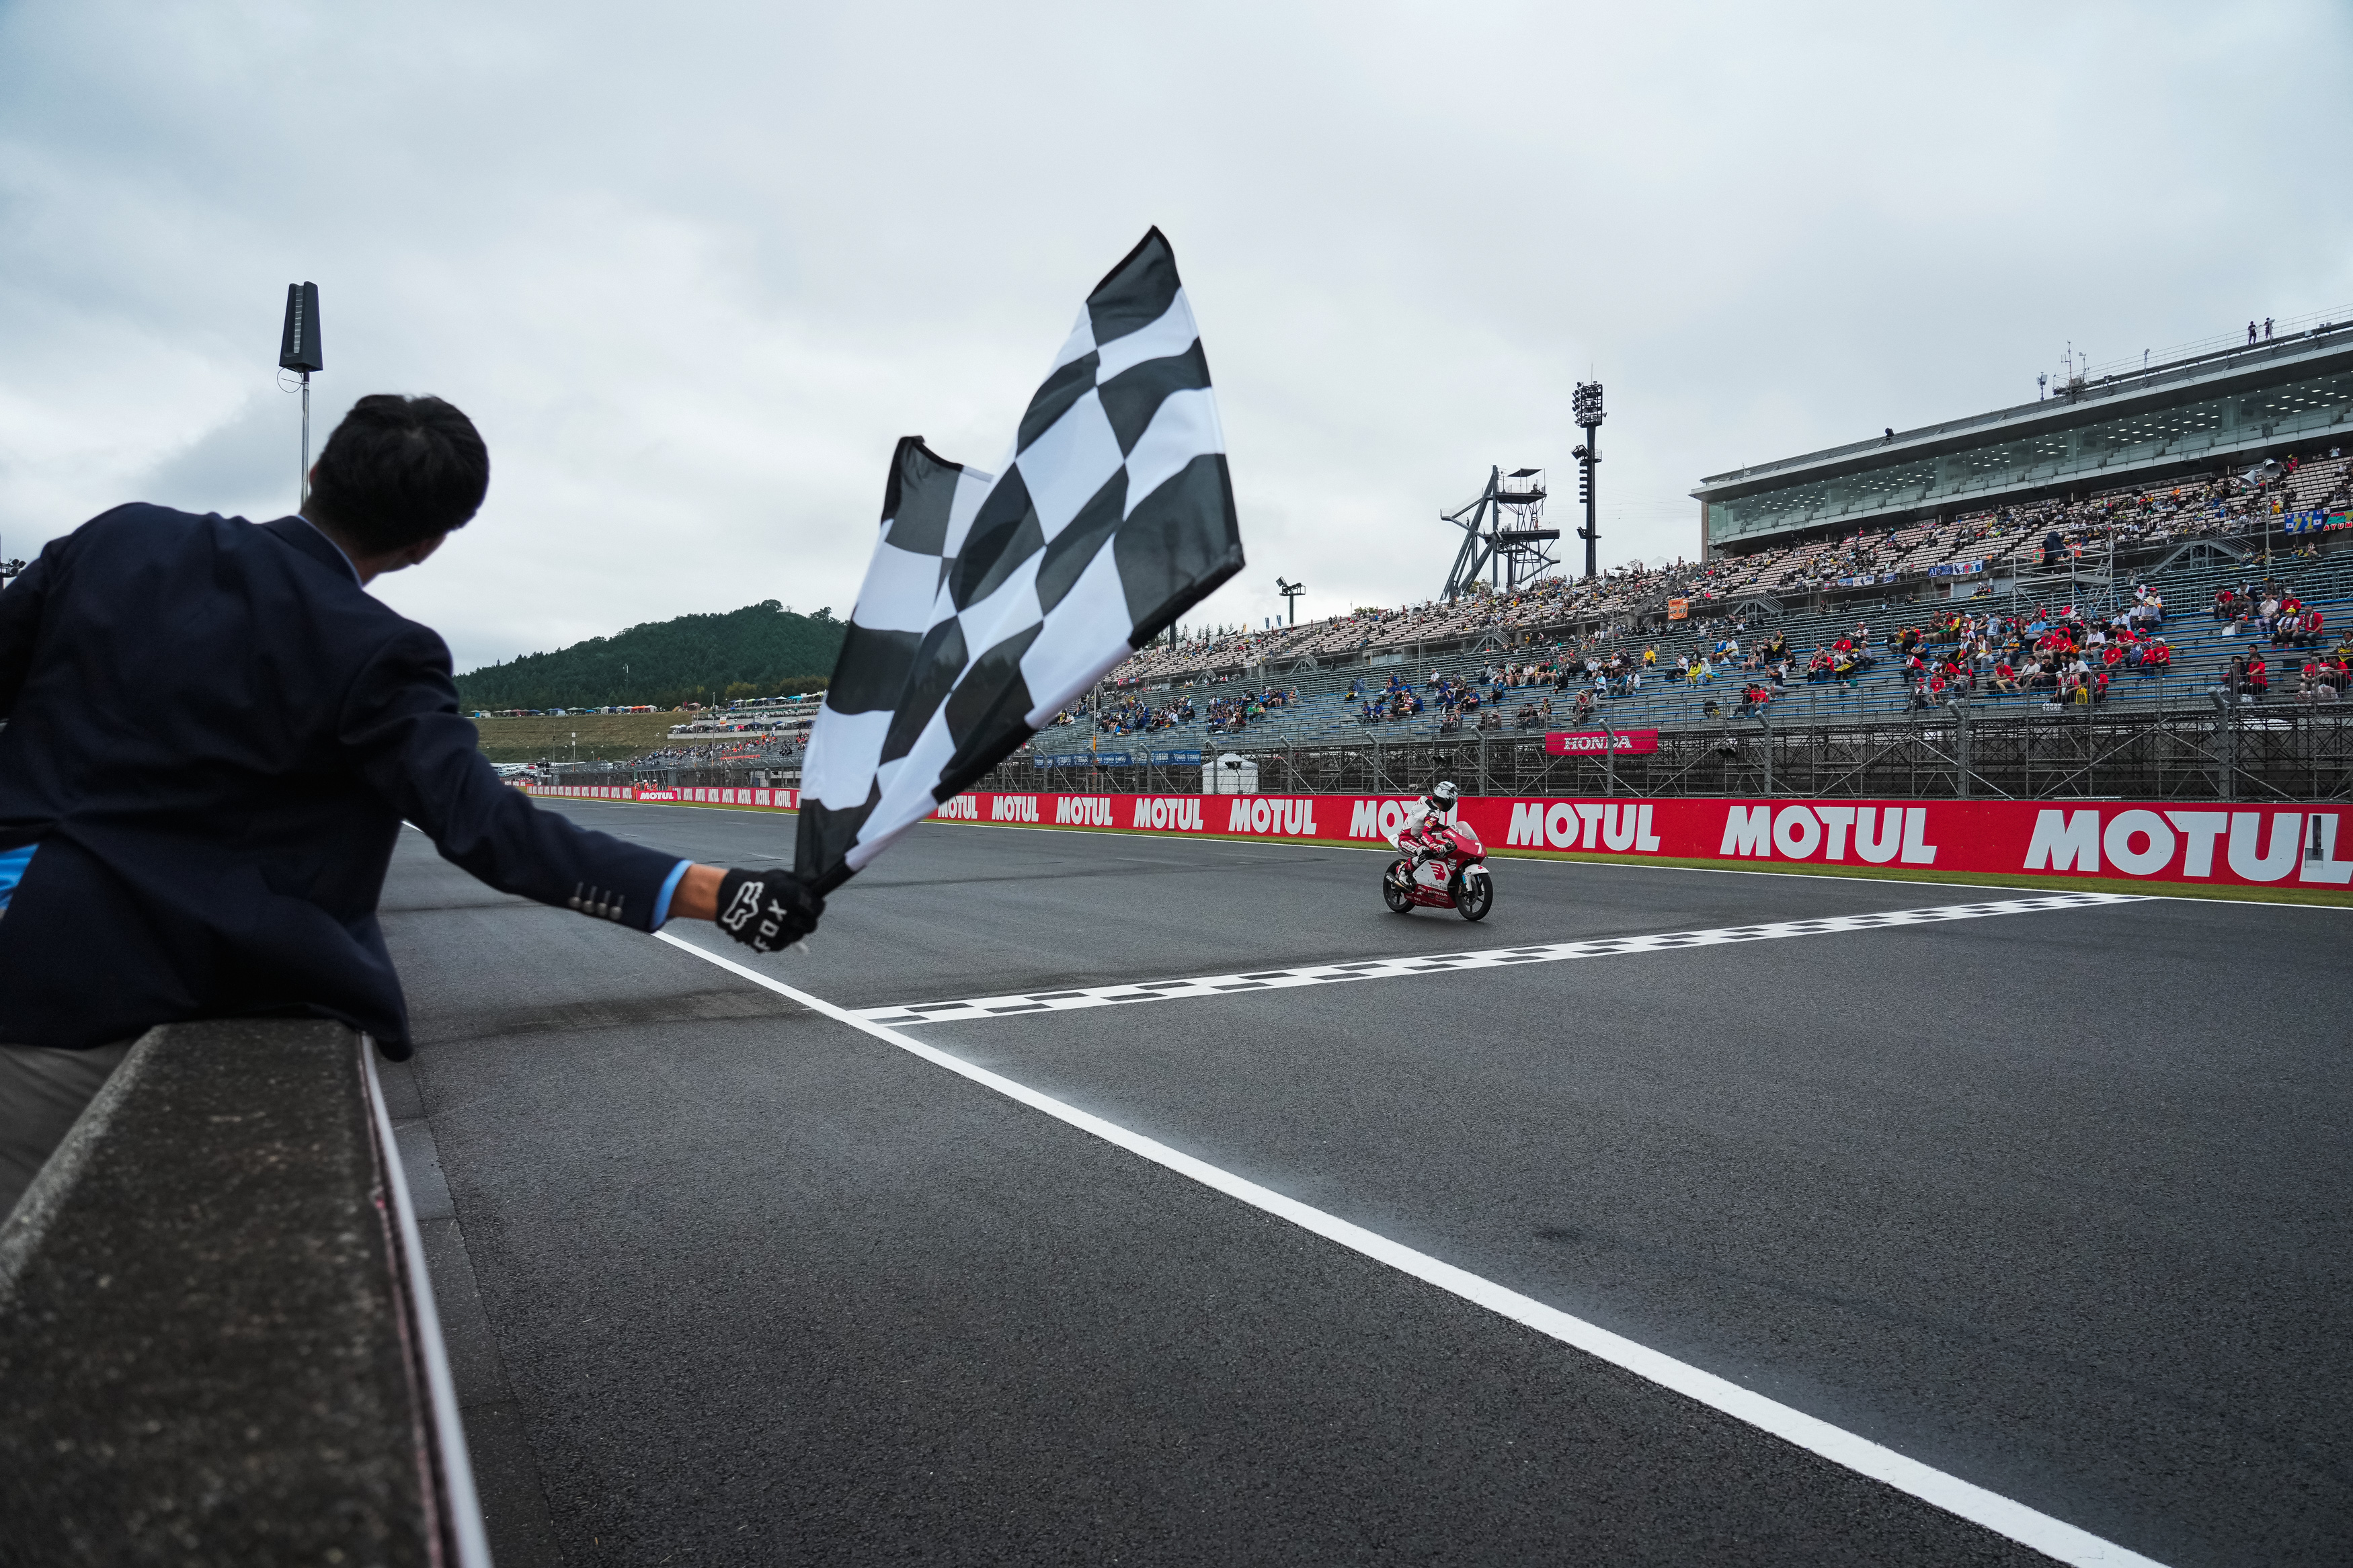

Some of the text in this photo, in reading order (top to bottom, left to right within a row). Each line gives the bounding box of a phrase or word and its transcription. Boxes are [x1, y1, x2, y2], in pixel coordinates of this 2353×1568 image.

[2293, 516, 2313, 531] 71
[1564, 736, 1632, 750] HONDA
[640, 792, 674, 800] MOTUL
[708, 788, 719, 802] MOTUL
[722, 789, 734, 803] MOTUL
[737, 789, 751, 804] MOTUL
[755, 790, 770, 806] MOTUL
[774, 790, 791, 808] MOTUL
[937, 795, 978, 819] MOTUL
[991, 796, 1039, 822] MOTUL
[1055, 796, 1113, 826] MOTUL
[1133, 798, 1203, 830] MOTUL
[1228, 798, 1317, 835] MOTUL
[1507, 802, 1661, 852] MOTUL
[1720, 805, 1937, 864] MOTUL
[2023, 809, 2353, 884] MOTUL
[1427, 889, 1448, 897] HONDA
[1428, 882, 1447, 891] idemitsu
[754, 898, 788, 952] FOX
